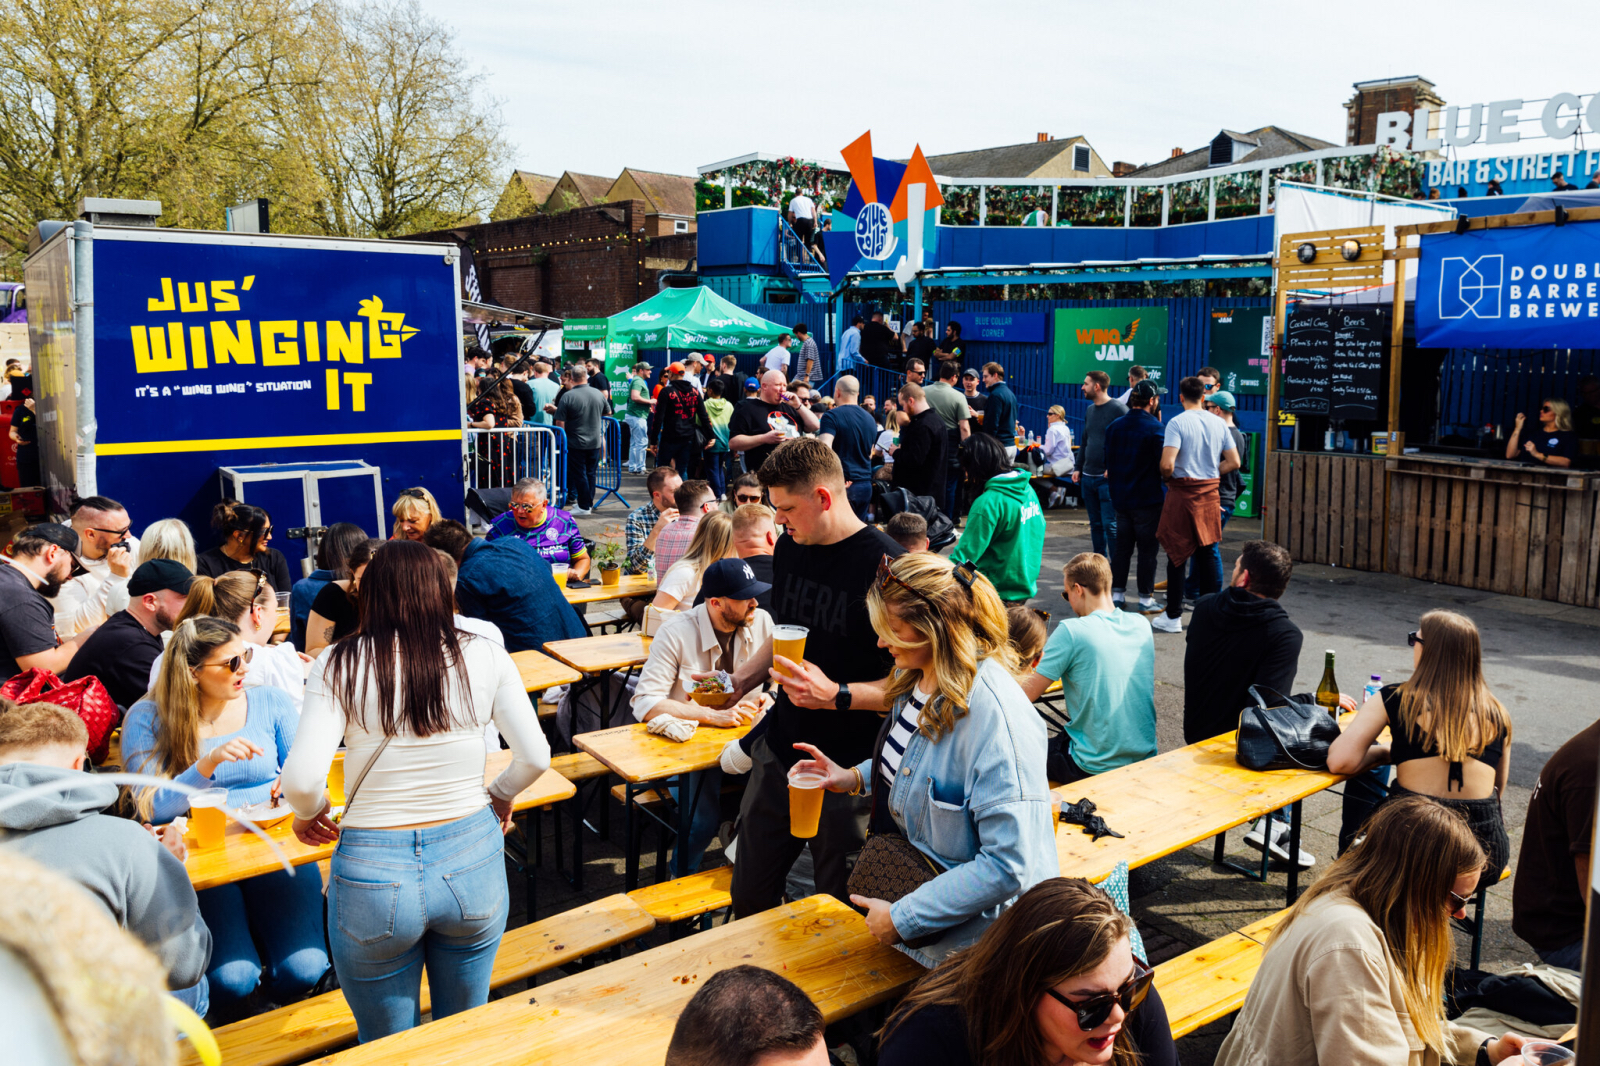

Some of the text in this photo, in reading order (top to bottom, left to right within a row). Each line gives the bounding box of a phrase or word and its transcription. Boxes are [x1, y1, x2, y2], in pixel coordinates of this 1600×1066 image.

[1375, 99, 1523, 152] BLUE
[1428, 149, 1600, 187] BAR & STREET F
[1509, 282, 1597, 300] BARRE
[1509, 302, 1599, 318] BREWE
[709, 318, 753, 328] Sprite
[975, 316, 1013, 326] BLUE COLLAR
[1343, 315, 1365, 327] Beers
[130, 309, 407, 374] WINGING
[682, 333, 708, 345] Sprite
[716, 335, 740, 346] Sprite
[747, 337, 771, 347] Sprite
[981, 328, 1005, 338] CORNER
[1075, 328, 1121, 345] WING
[1095, 344, 1134, 361] JAM
[135, 385, 159, 398] IT'S
[162, 386, 172, 397] A
[255, 380, 312, 393] SITUATION
[325, 369, 373, 412] IT
[781, 573, 849, 638] HERA
